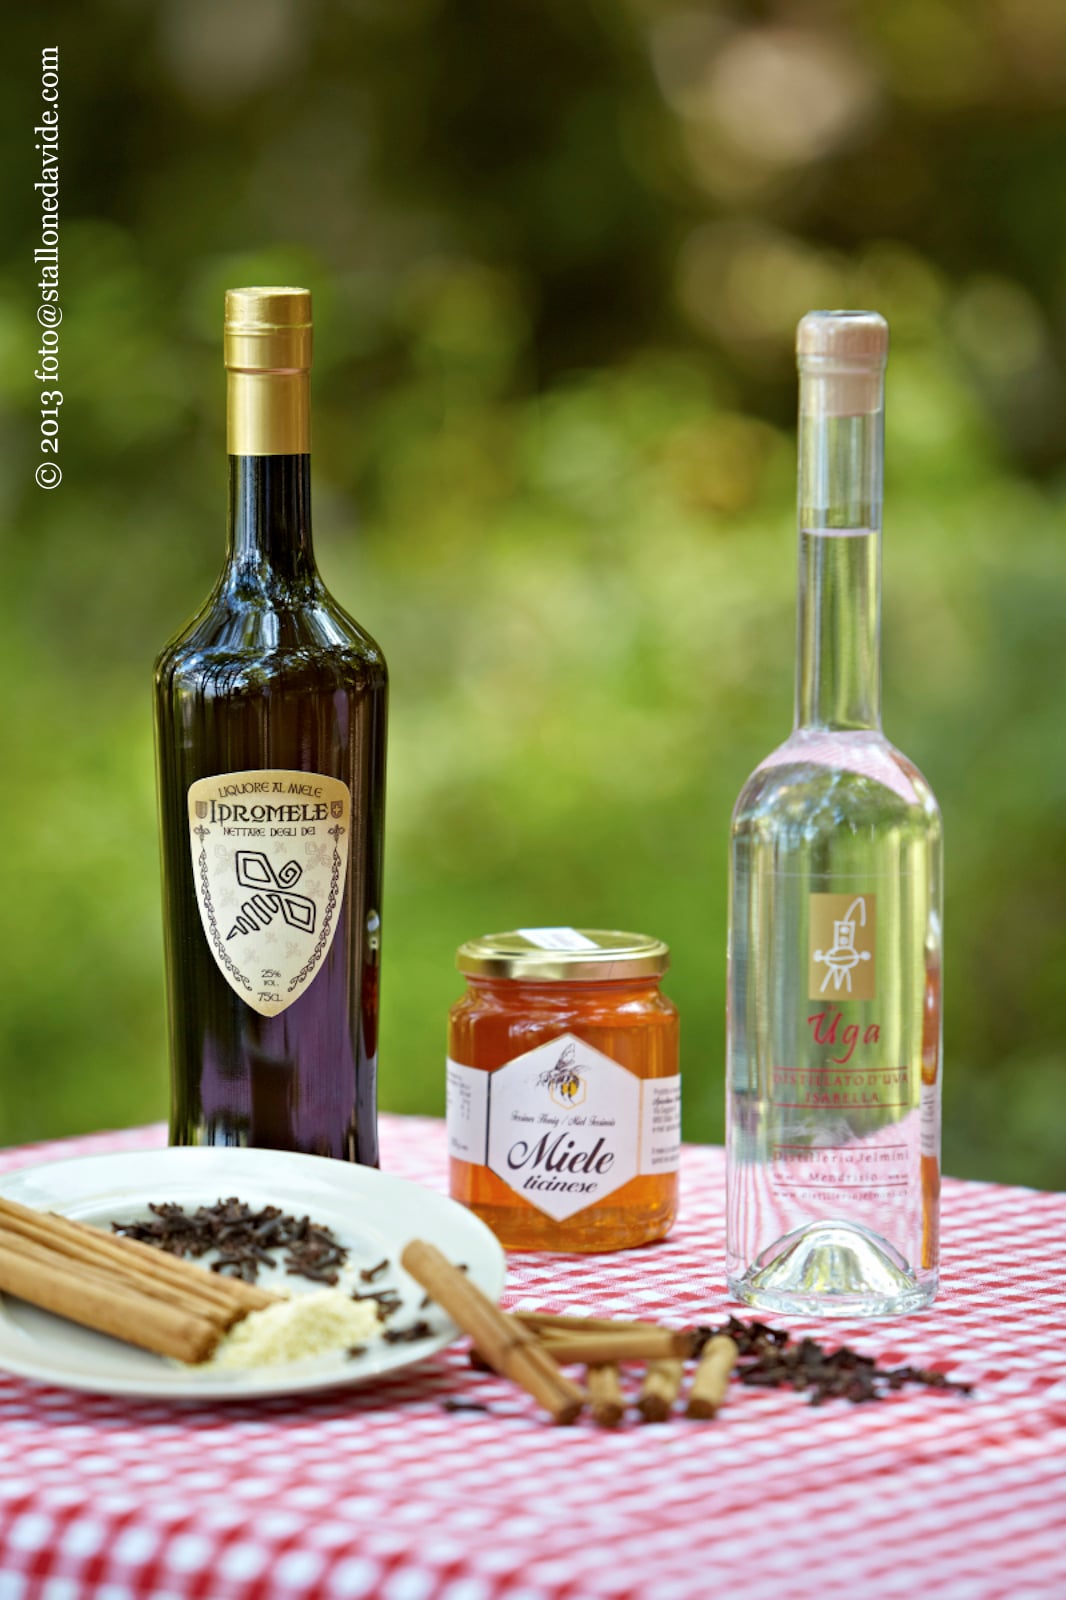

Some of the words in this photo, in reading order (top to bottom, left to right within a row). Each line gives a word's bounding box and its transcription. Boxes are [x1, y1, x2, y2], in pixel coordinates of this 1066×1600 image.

[218, 782, 269, 798] LIQUORE
[272, 782, 286, 793] AL
[287, 783, 323, 798] MIELE
[223, 827, 266, 837] NETTARE
[270, 827, 297, 837] DEGLI
[301, 826, 316, 836] DEI
[805, 1092, 879, 1104] ISABELLA
[507, 1131, 615, 1175] Miele
[522, 1174, 599, 1194] ticinese
